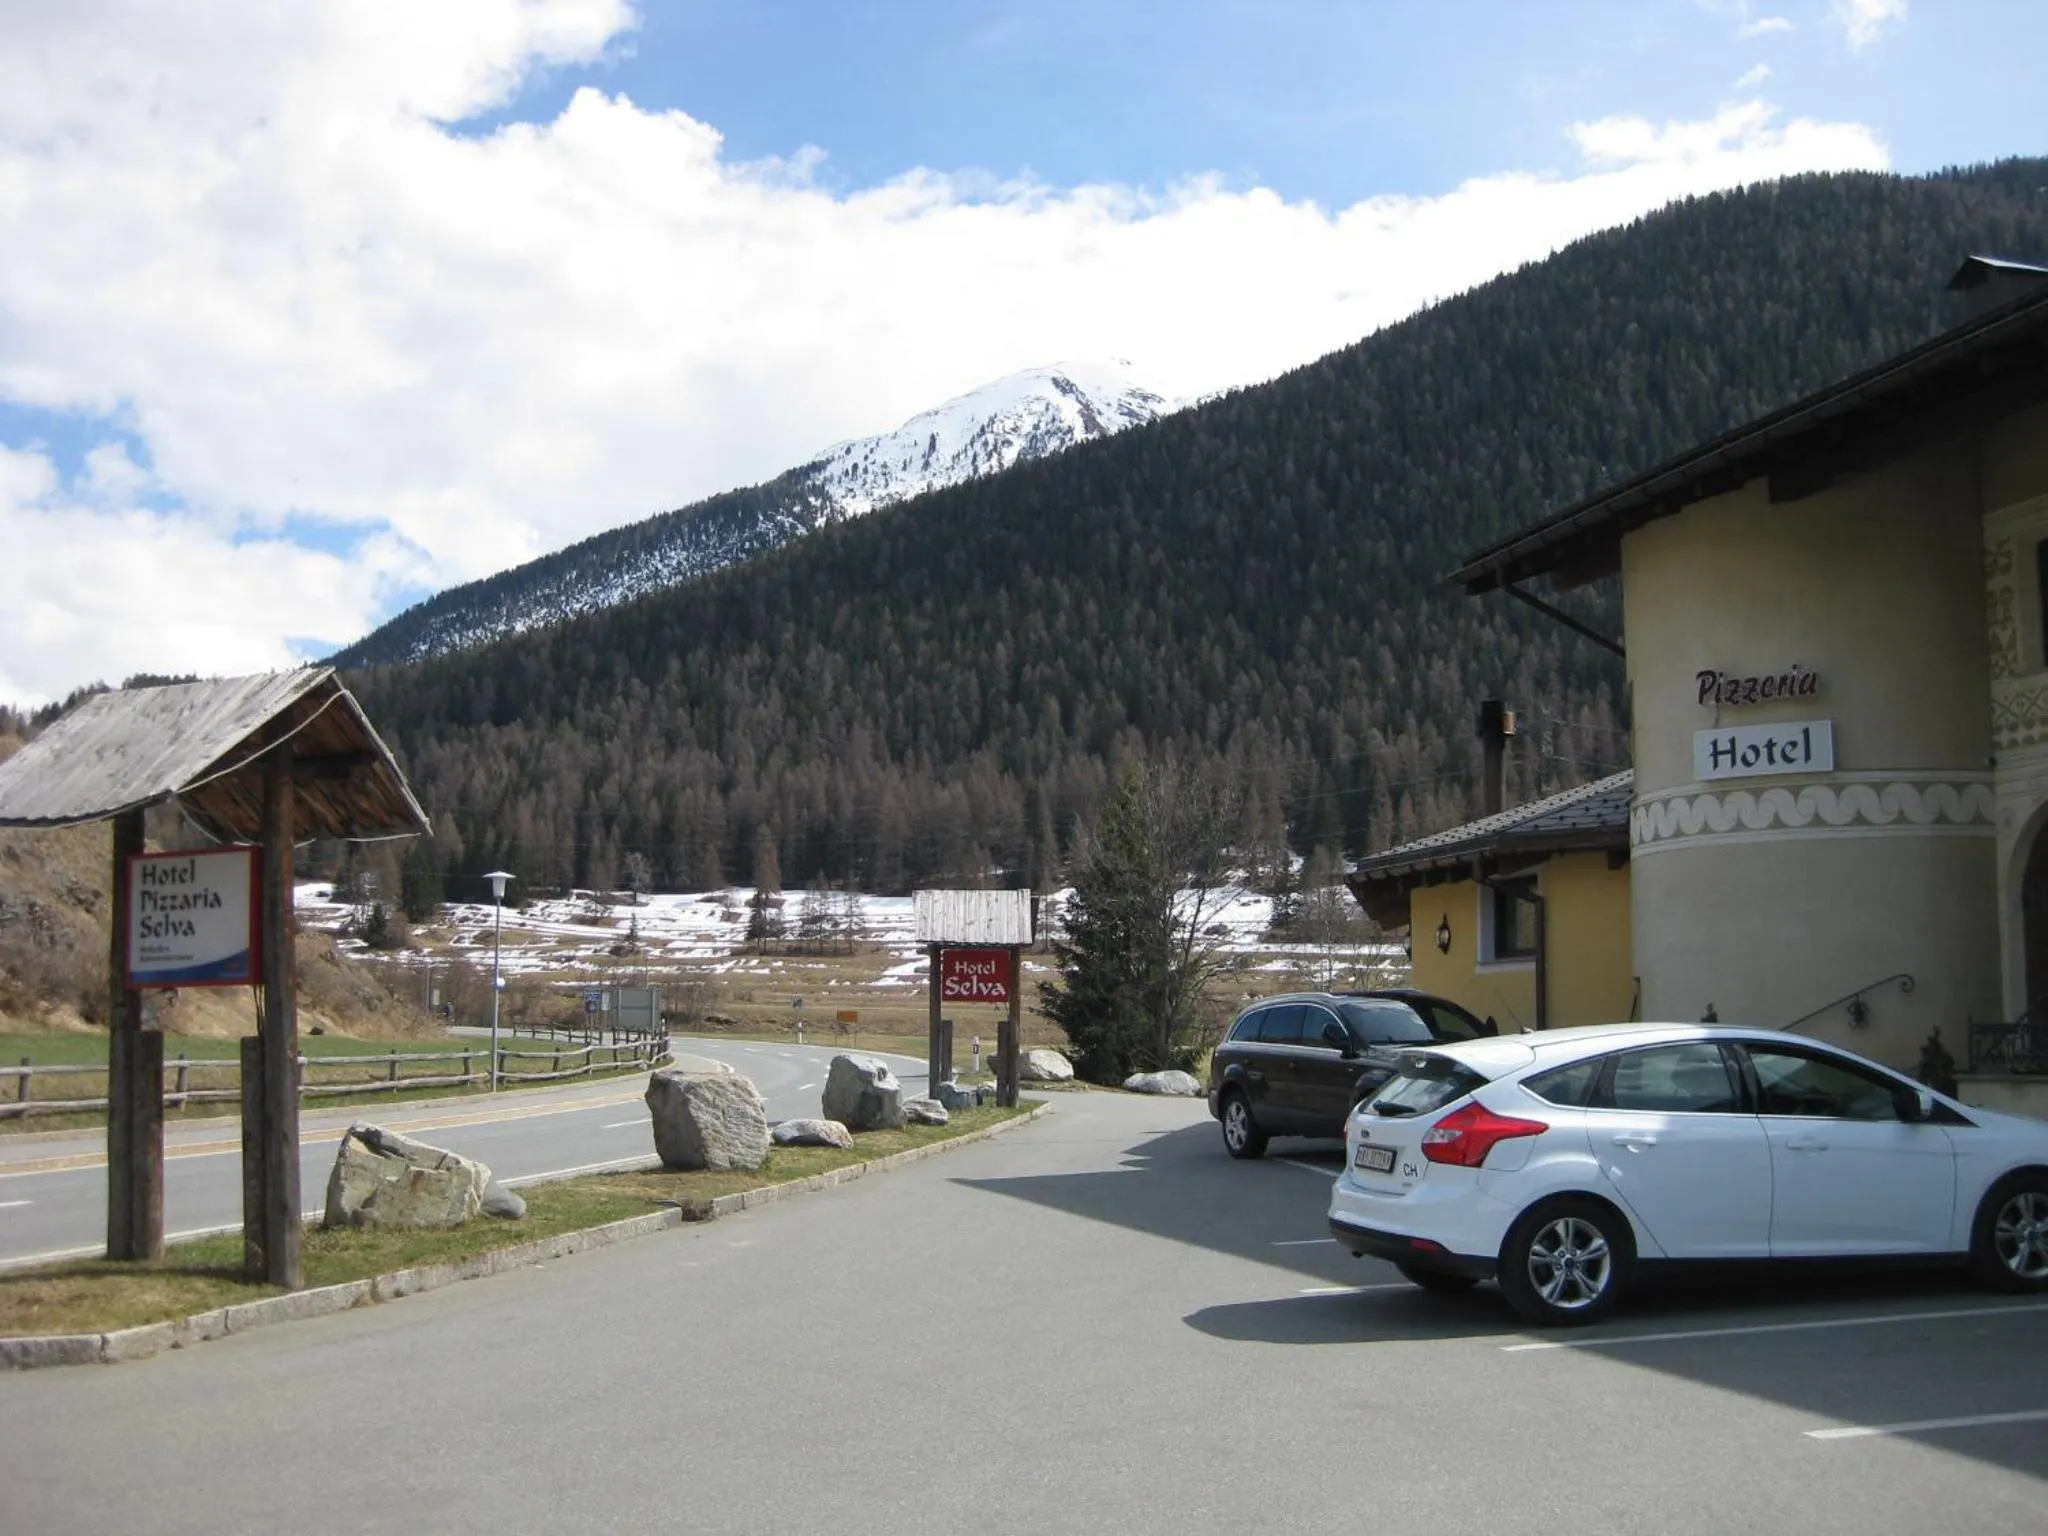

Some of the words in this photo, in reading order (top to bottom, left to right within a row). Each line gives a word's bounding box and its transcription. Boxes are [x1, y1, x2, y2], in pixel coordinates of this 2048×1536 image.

[1696, 664, 1817, 705] Pizzeria
[1709, 726, 1812, 771] Hotel
[141, 858, 195, 886] Hotel
[141, 887, 222, 912] Pizzaria
[140, 912, 195, 938] Selva
[955, 960, 995, 974] Hotel
[945, 974, 1006, 996] Selva
[1403, 1163, 1418, 1177] CH
